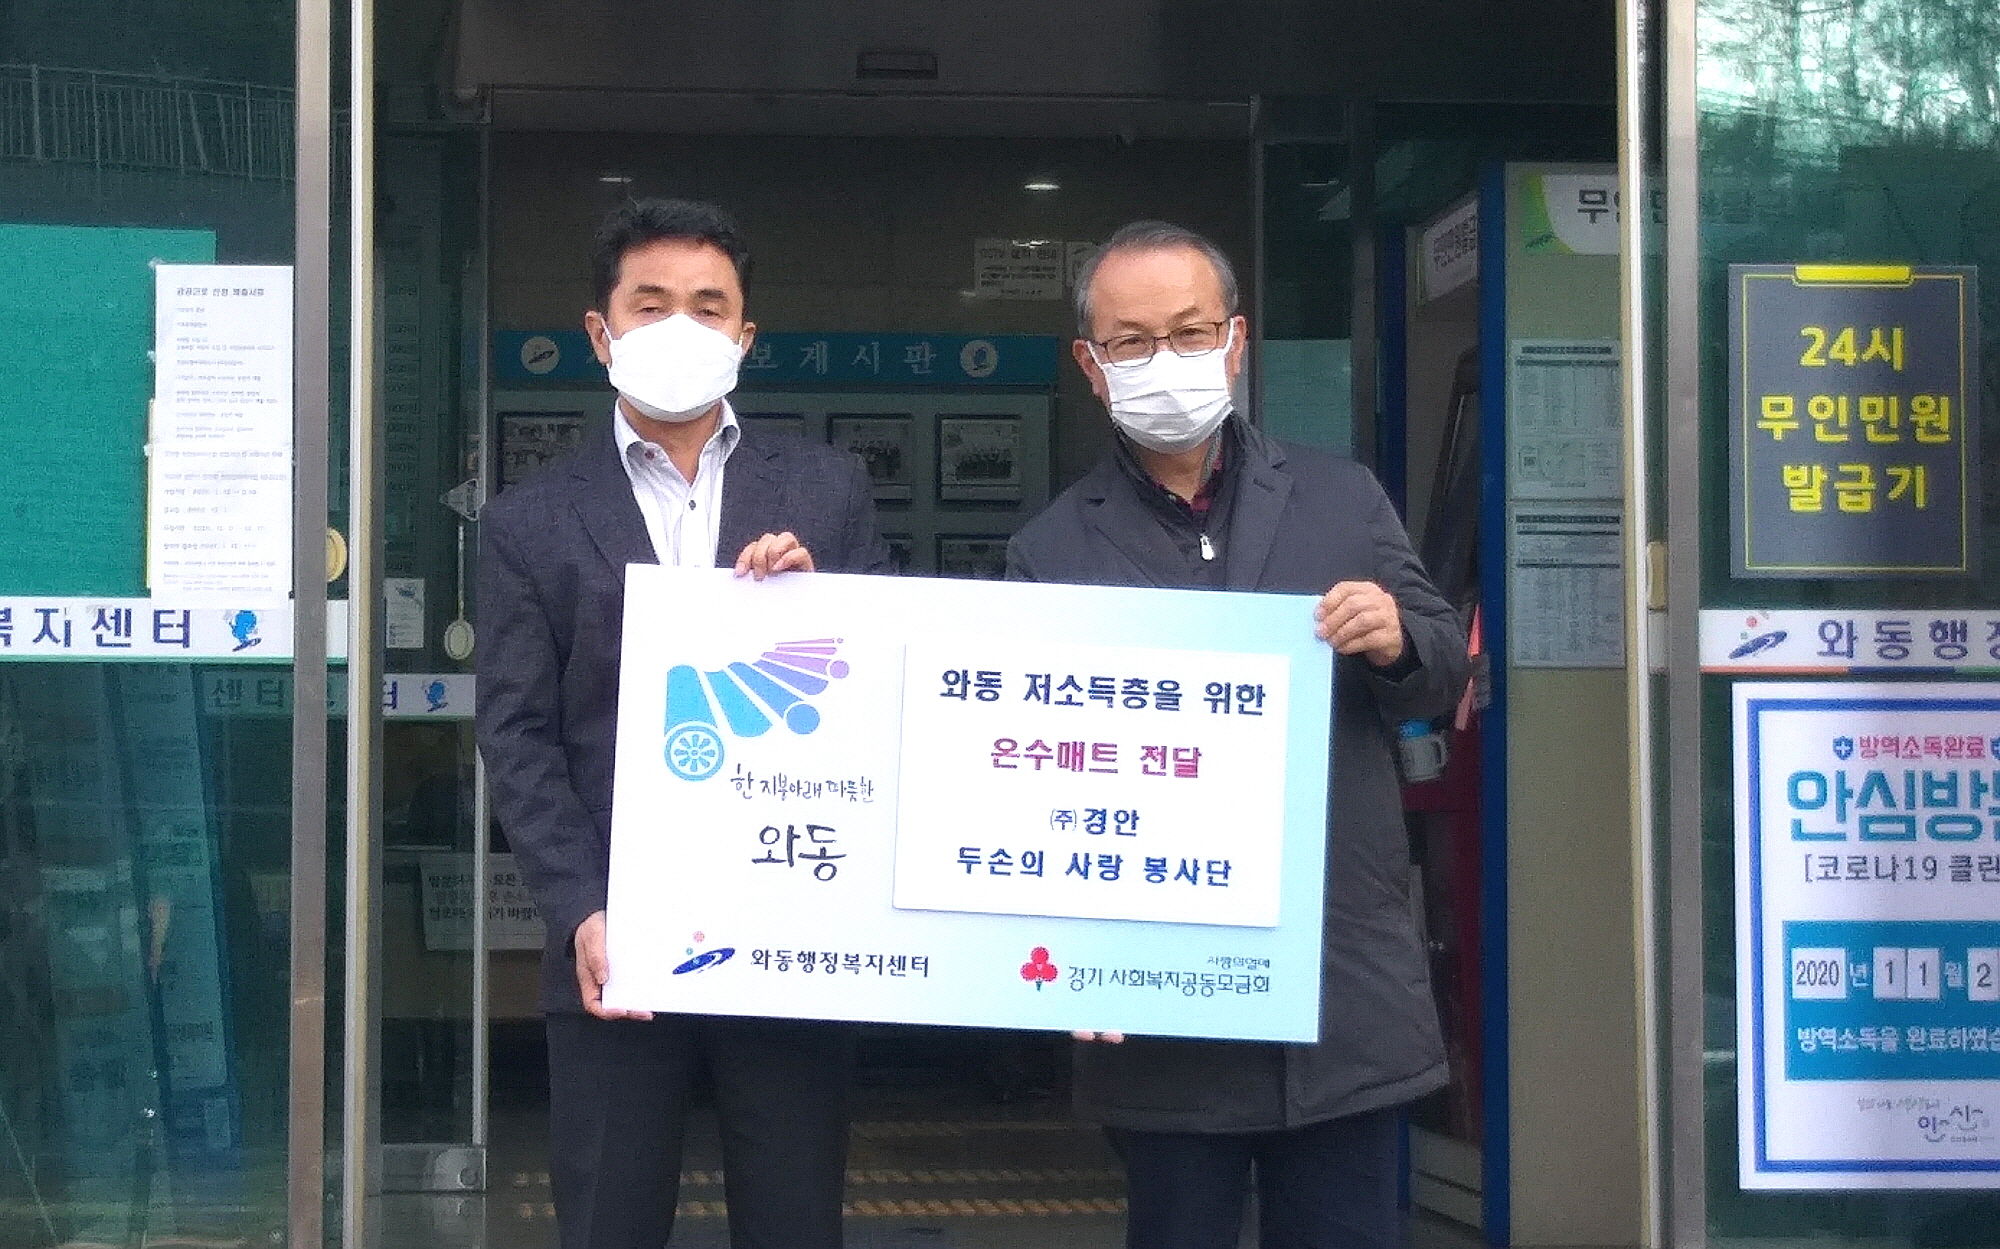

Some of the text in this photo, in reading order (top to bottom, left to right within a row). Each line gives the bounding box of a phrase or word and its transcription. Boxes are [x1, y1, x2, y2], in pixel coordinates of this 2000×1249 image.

[1800, 326, 1904, 371] 24시
[1756, 394, 1952, 443] 무인민원
[1782, 464, 1928, 513] 발급기
[940, 669, 1266, 716] 와동 저소득층을 위한
[991, 738, 1202, 779] 온수매트 전달
[1859, 736, 1986, 760] 방역소독완료
[730, 763, 754, 800] 한
[1787, 770, 2000, 842] 안심방
[751, 824, 848, 882] 와동
[957, 847, 1232, 888] 두손의 사랑 봉사단
[751, 949, 929, 978] 와동행정복지센터
[1069, 966, 1270, 997] 경기 사회복지공동모금회
[1797, 1026, 1900, 1052] 방역소독을
